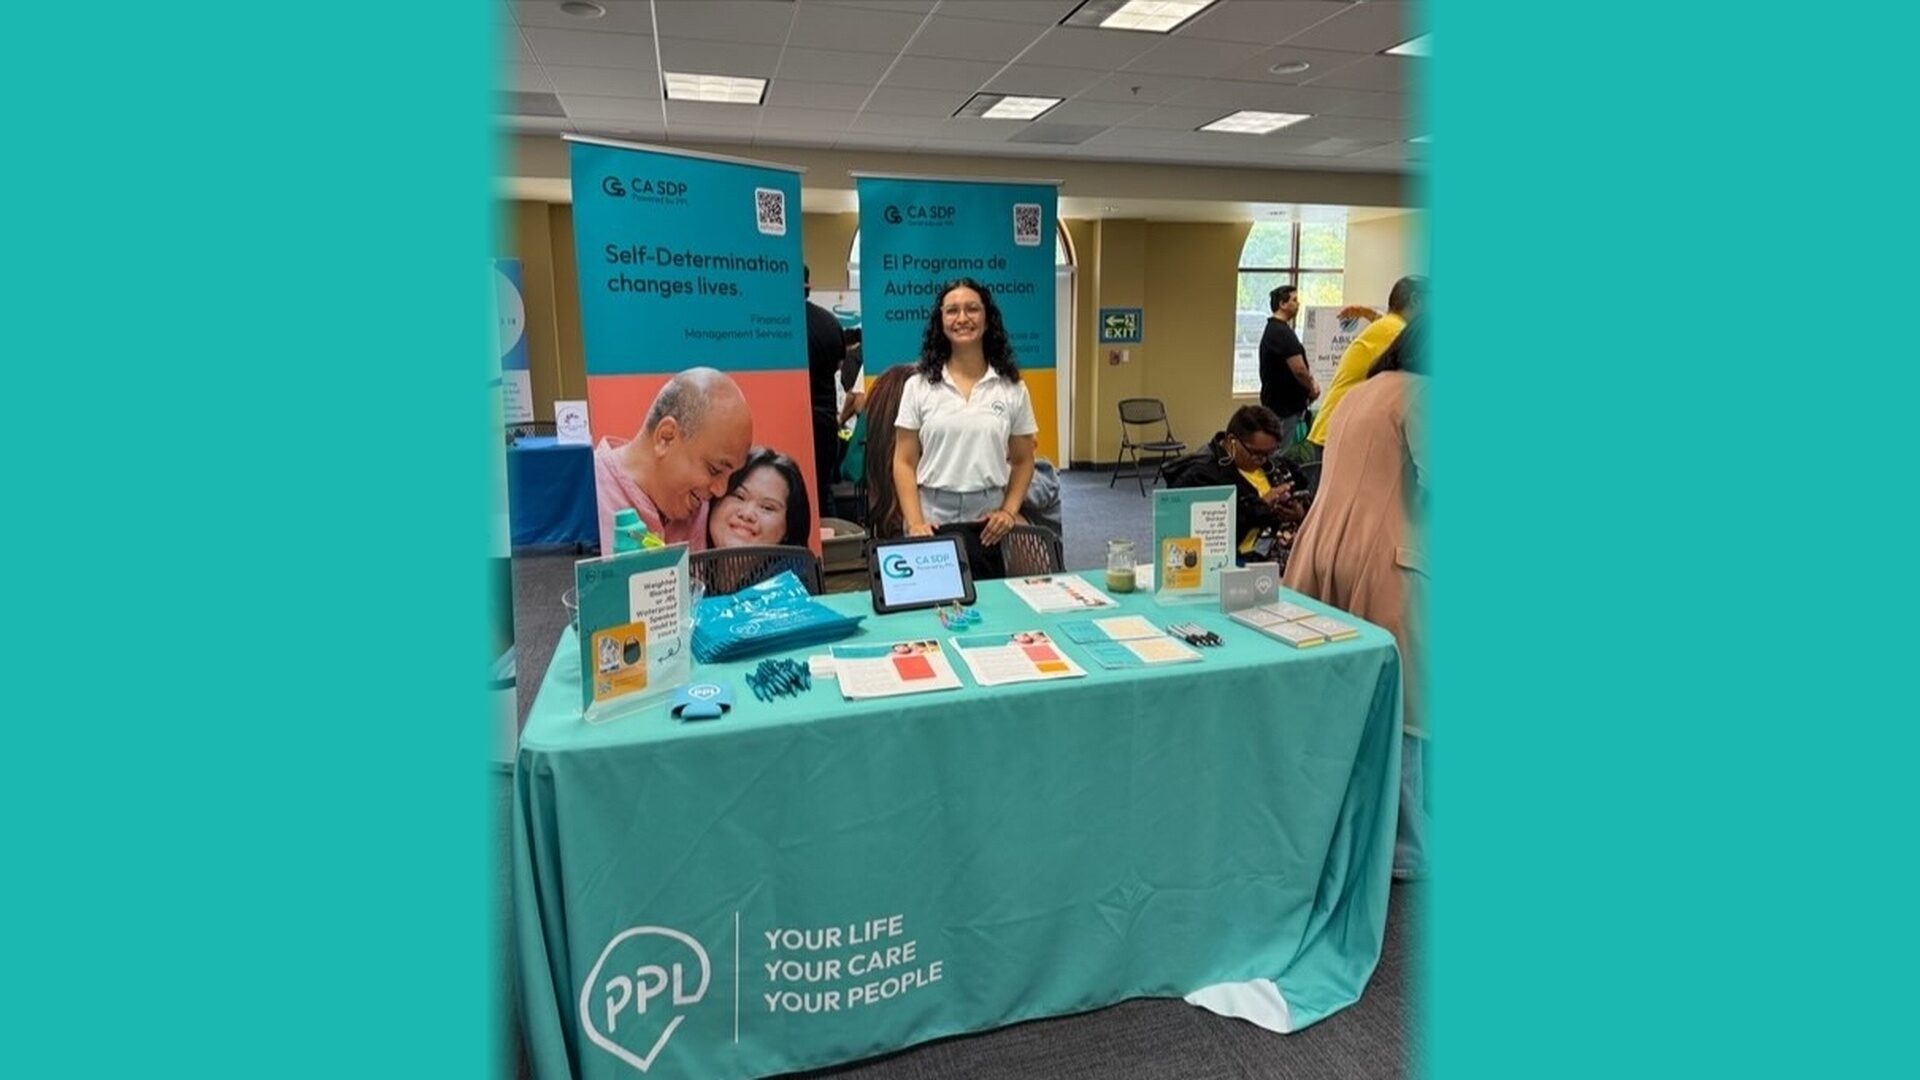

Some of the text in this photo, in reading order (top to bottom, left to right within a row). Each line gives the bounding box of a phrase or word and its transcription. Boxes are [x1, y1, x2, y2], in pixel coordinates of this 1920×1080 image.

[631, 178, 653, 193] CA
[657, 180, 687, 197] SDP
[907, 205, 927, 219] CA
[930, 206, 956, 220] SDP
[605, 244, 789, 274] Self-Determination
[883, 254, 1007, 274] El Programa de
[607, 273, 743, 299] changes lives.
[684, 328, 752, 341] Management
[1105, 327, 1135, 339] EXIT
[764, 914, 904, 951] YOUR LIFE
[764, 940, 917, 983] YOUR CARE
[605, 963, 700, 1034] PPL
[764, 960, 944, 1014] YOUR PEOPLE
